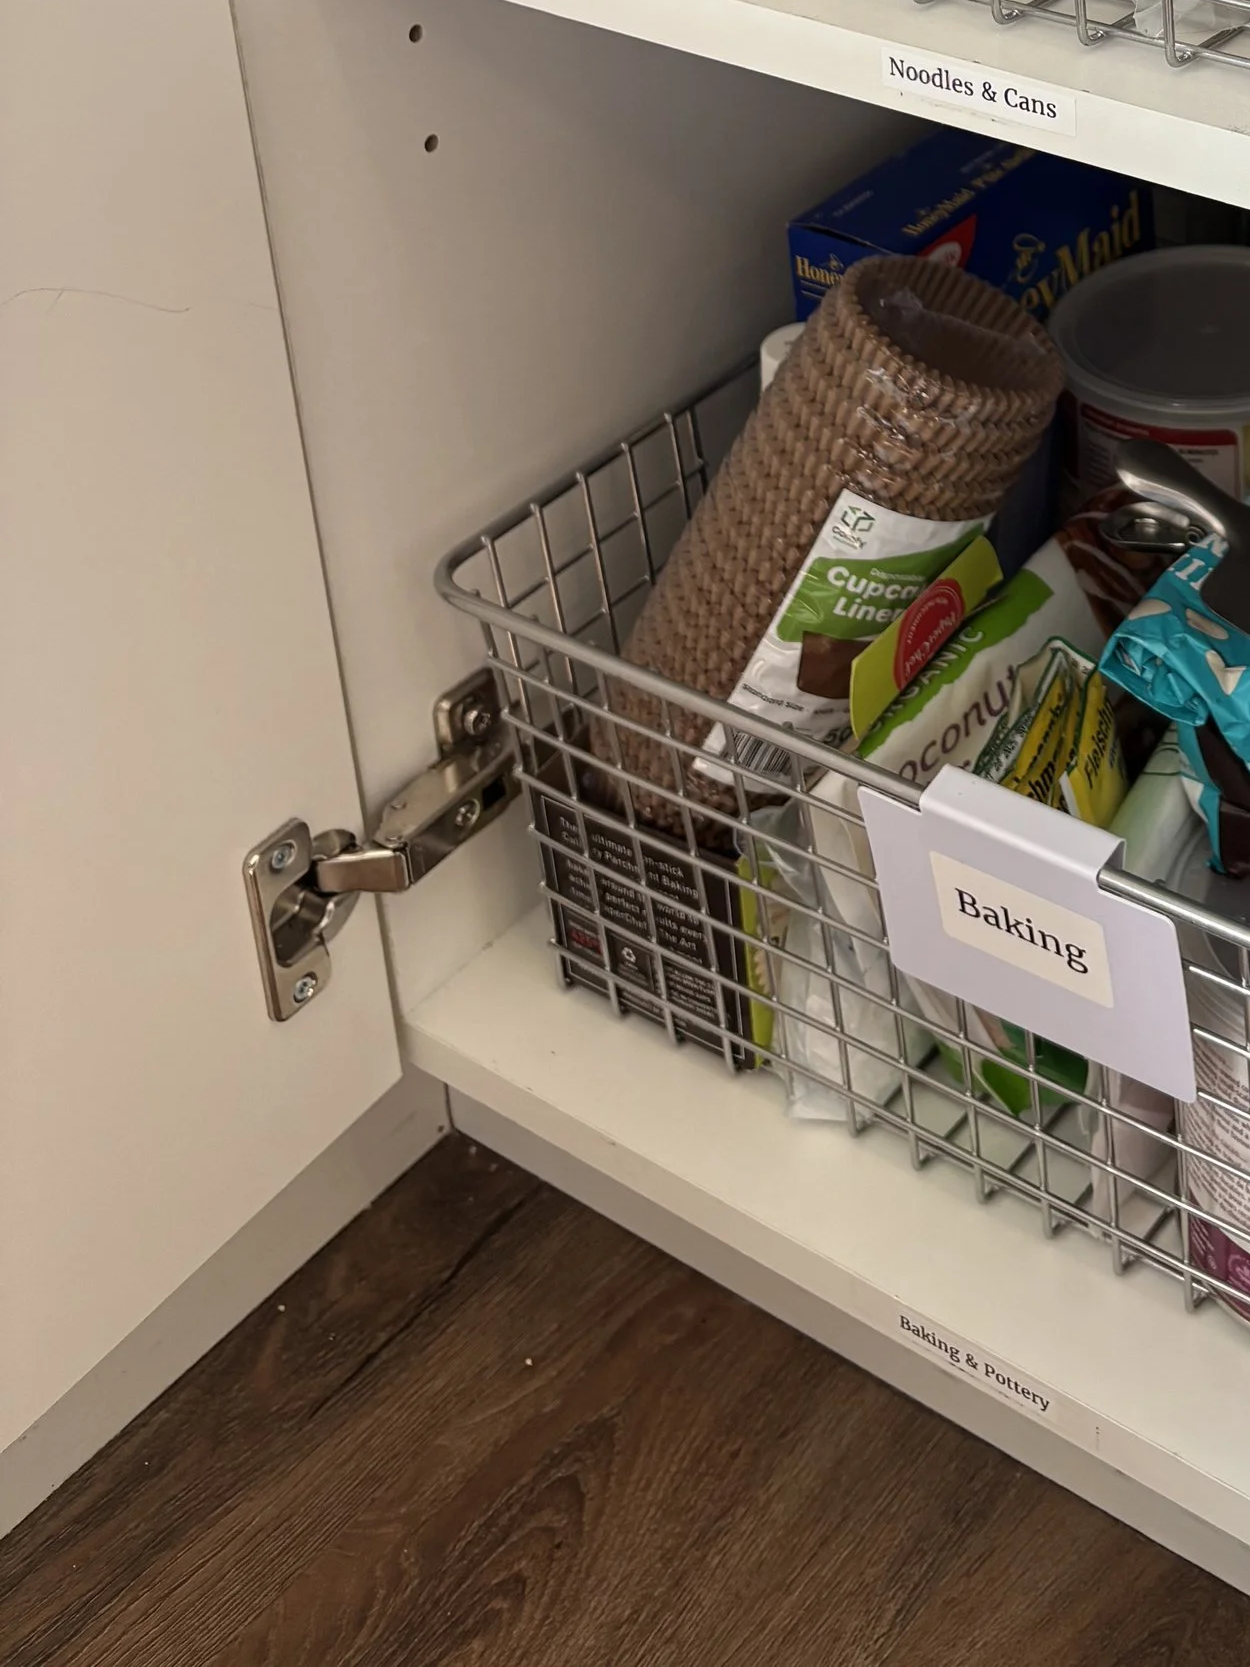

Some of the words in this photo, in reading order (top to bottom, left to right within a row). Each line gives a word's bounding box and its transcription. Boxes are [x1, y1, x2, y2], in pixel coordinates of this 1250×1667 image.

[888, 56, 975, 98] Noodles
[981, 80, 998, 104] &
[1003, 88, 1060, 120] Cans
[954, 886, 1092, 976] Baking
[900, 1315, 960, 1364] Baking
[965, 1352, 979, 1370] &
[984, 1362, 1050, 1412] Pottery
